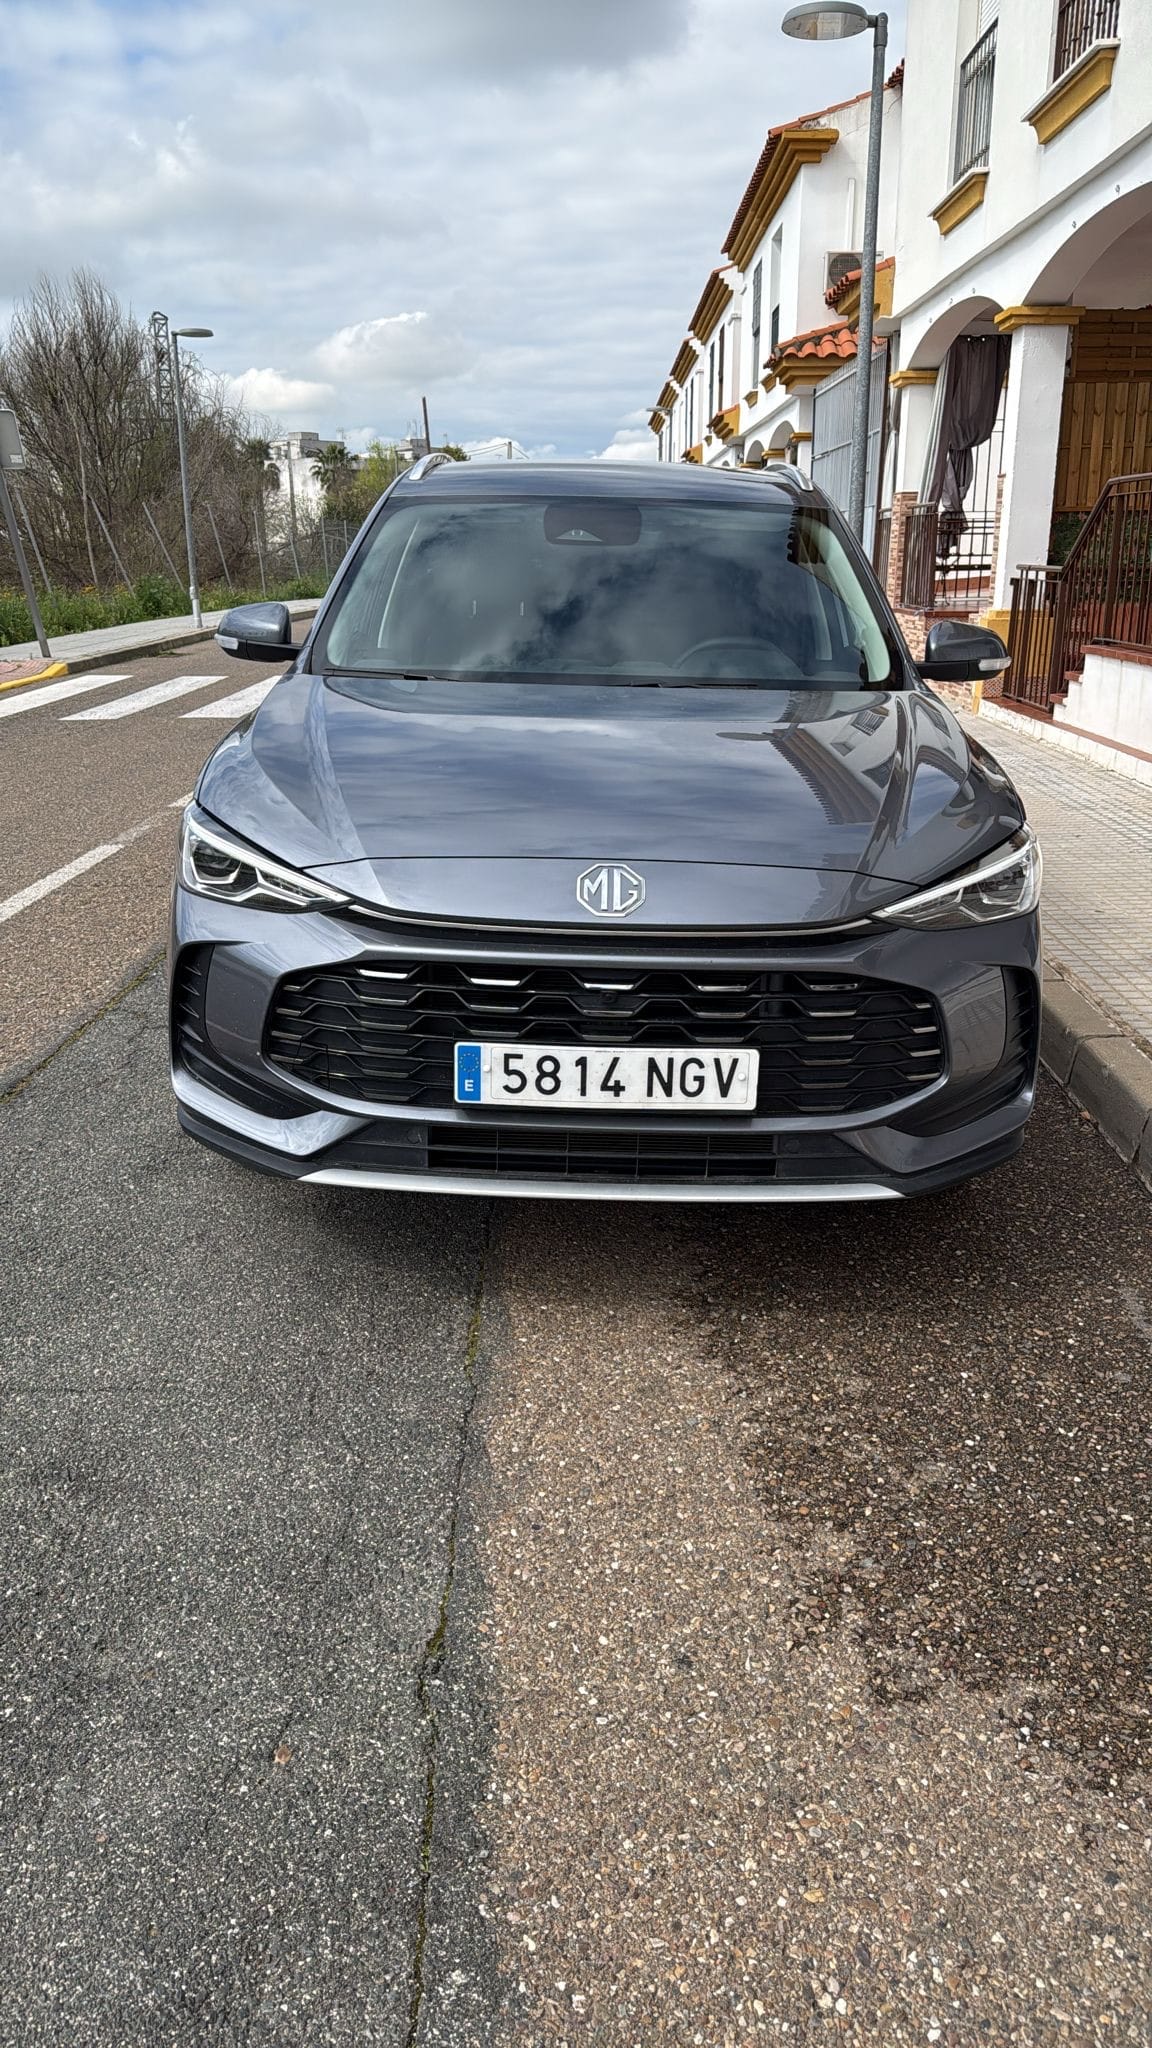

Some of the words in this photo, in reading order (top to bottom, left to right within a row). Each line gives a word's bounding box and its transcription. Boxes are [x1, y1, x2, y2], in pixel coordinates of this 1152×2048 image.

[583, 868, 639, 911] MG
[464, 1079, 474, 1092] E
[502, 1053, 626, 1097] 5814
[646, 1056, 739, 1098] NGV
